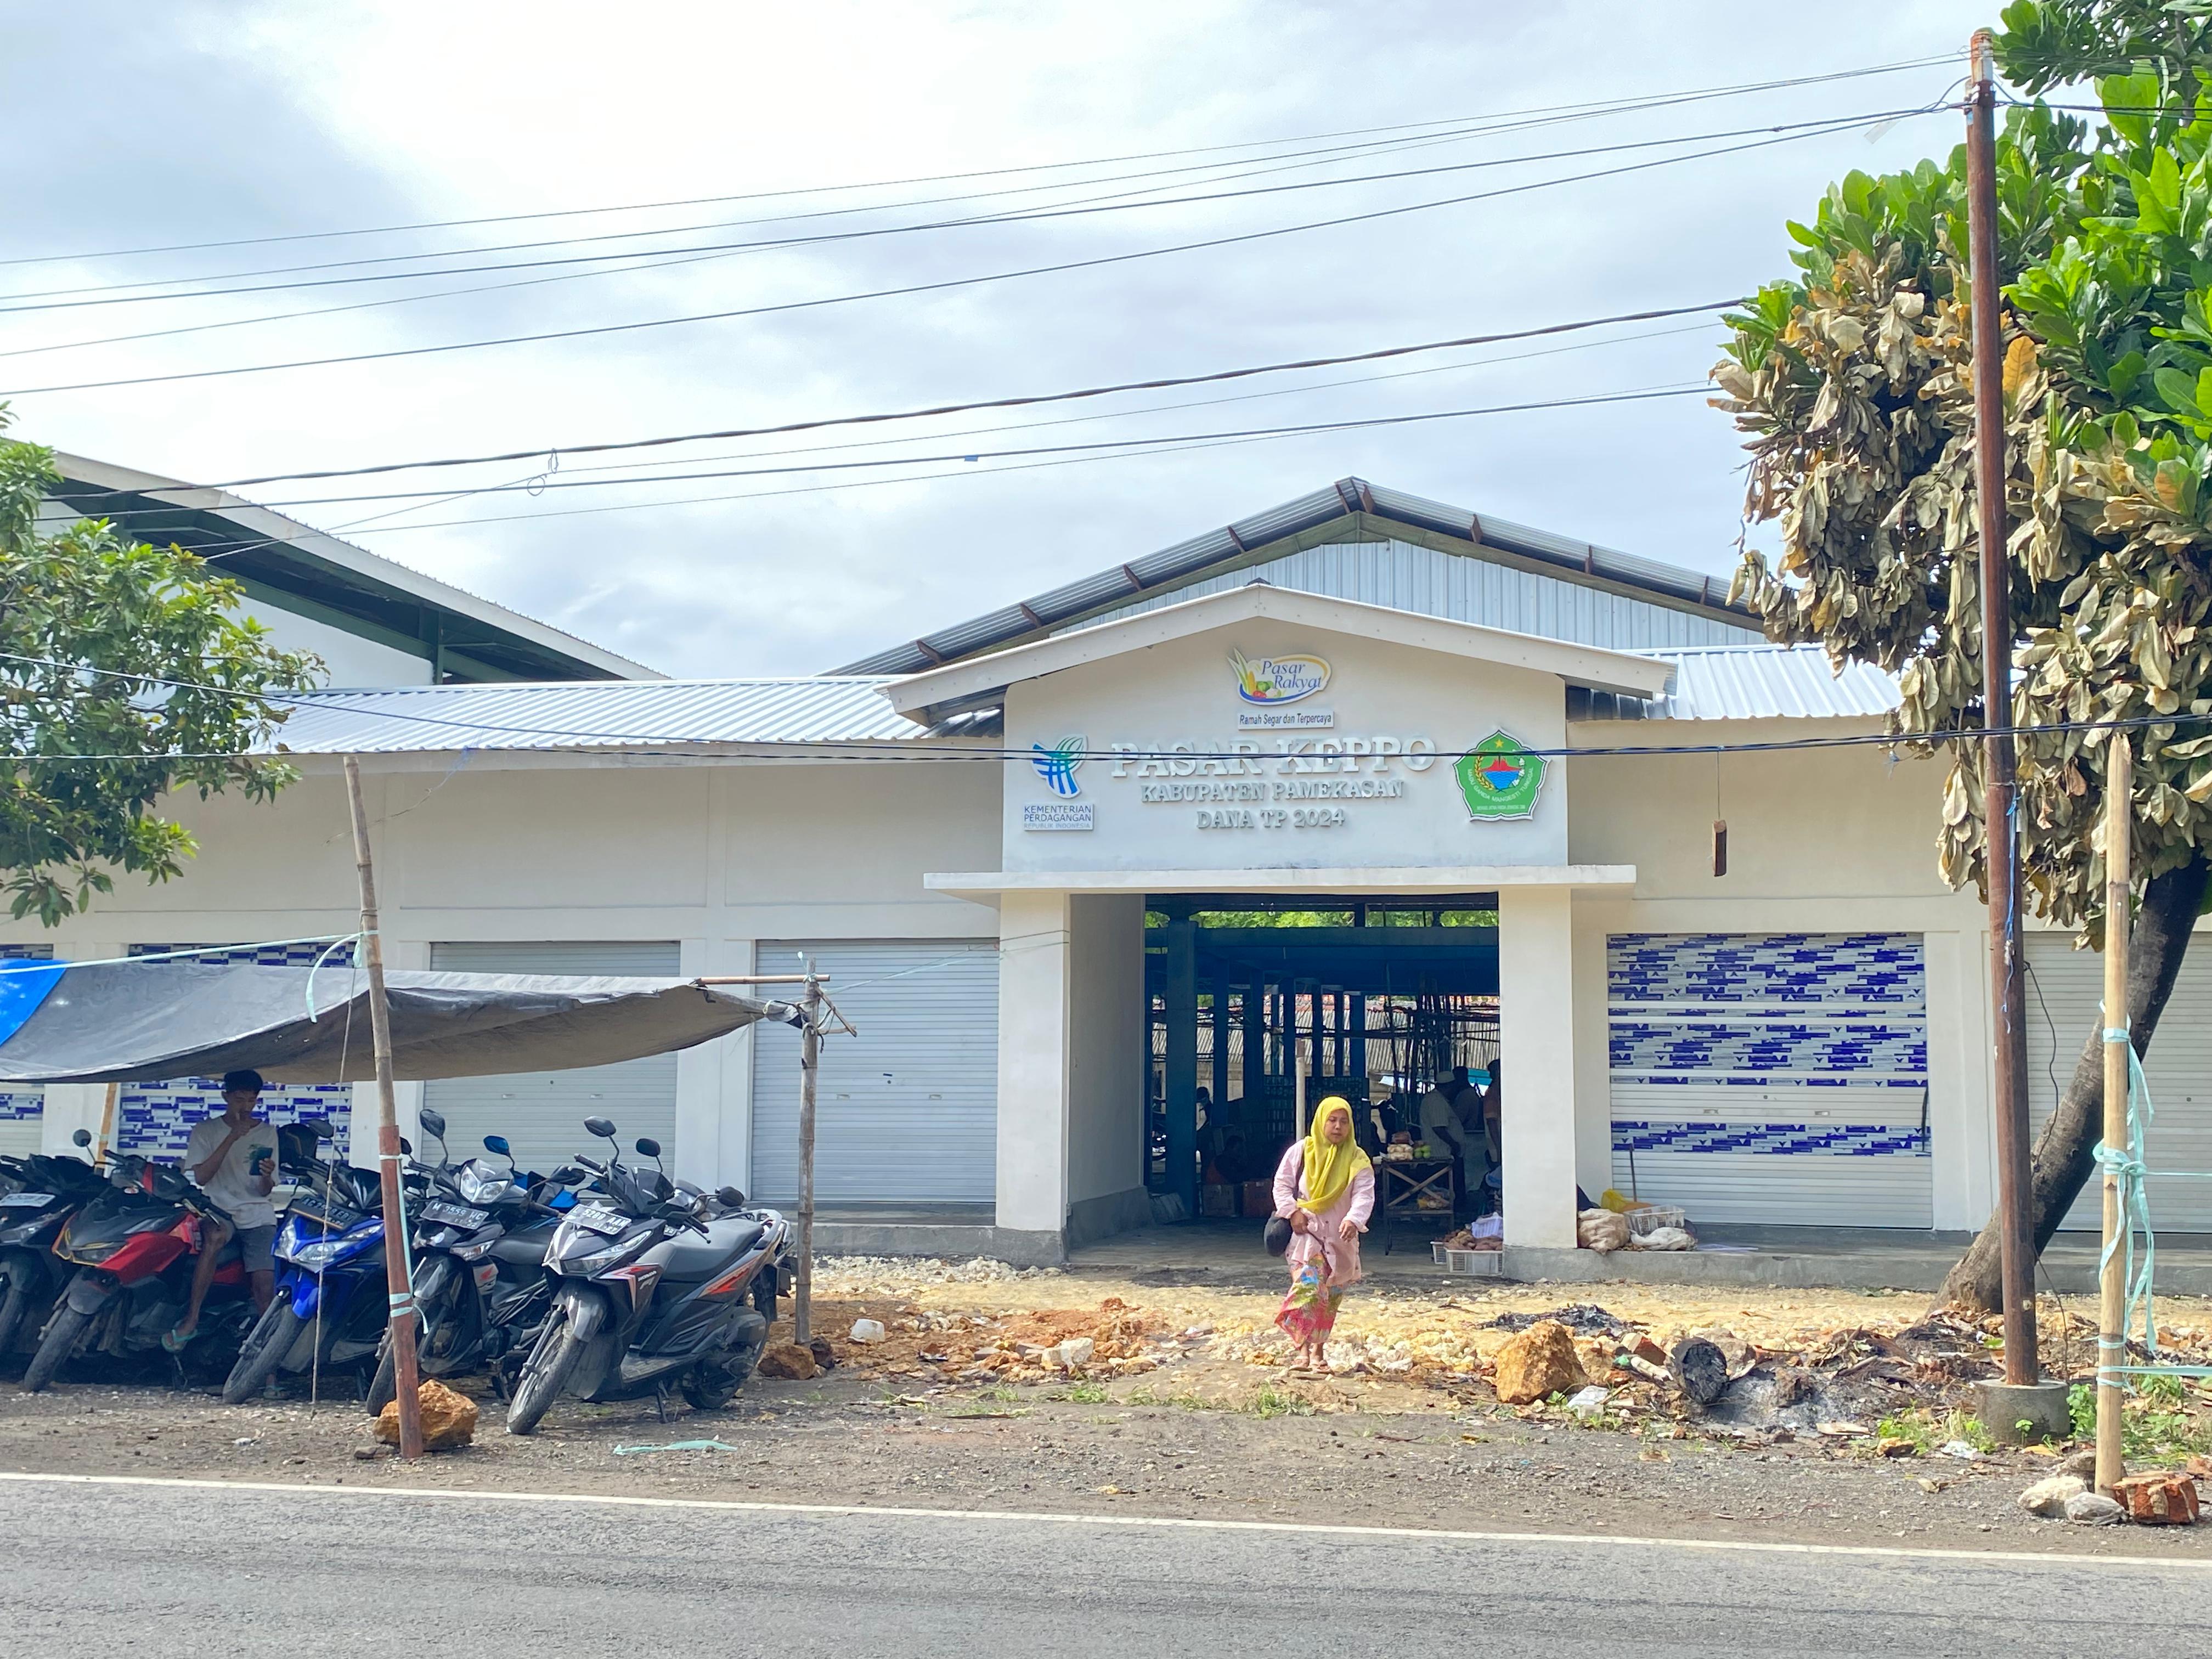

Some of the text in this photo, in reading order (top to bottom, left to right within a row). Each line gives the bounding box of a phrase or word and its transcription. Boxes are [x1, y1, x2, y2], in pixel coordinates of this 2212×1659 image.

[1262, 661, 1306, 675] Pasar
[1273, 675, 1322, 692] Rakyat
[1240, 713, 1331, 726] Ramah Segar dan Terpercaya
[1111, 737, 1436, 777] PASAR KEPPO
[1141, 780, 1404, 803] KABUPATEN PAMEKASAN
[1025, 805, 1091, 814] KEMENTERIAN
[1024, 814, 1091, 822] PERDAGANGAN
[1197, 809, 1345, 828] DANA TP 2024
